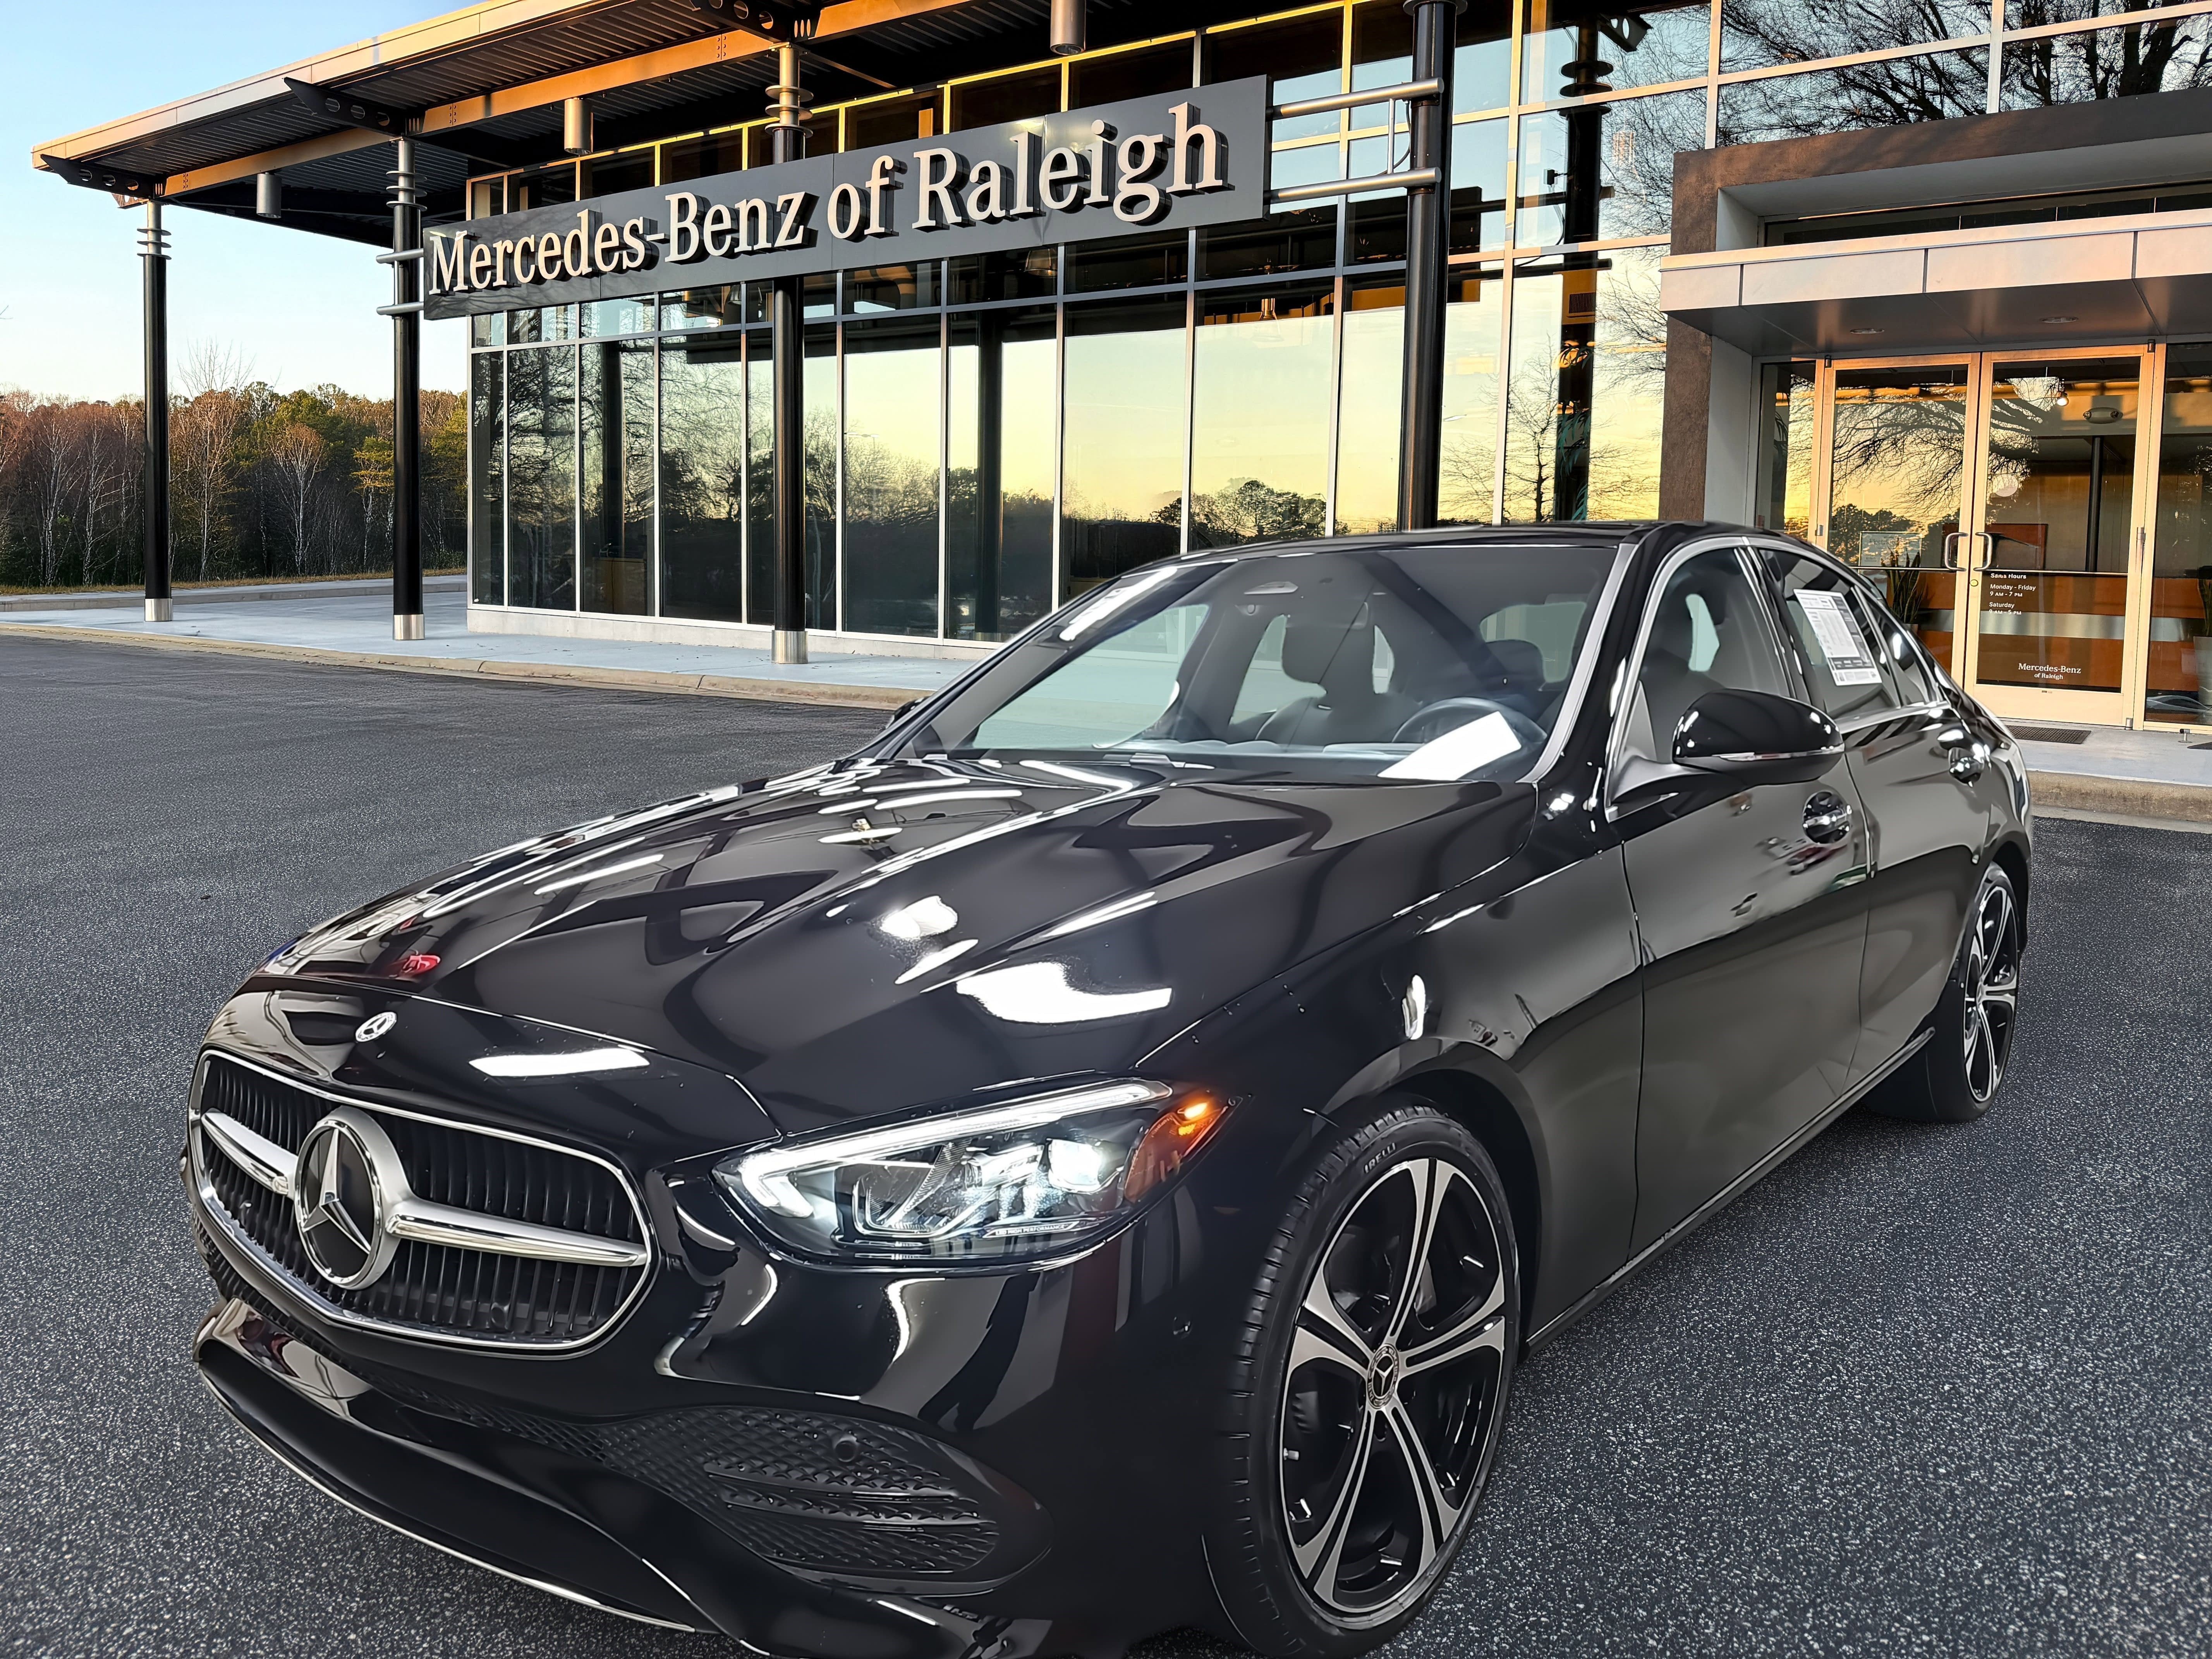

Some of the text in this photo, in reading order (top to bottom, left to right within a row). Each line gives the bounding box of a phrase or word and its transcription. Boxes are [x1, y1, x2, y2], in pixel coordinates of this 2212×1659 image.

[429, 102, 1223, 295] Mercedes-Benz of Raleigh
[2018, 663, 2081, 673] Mercedes-Benz
[1023, 1224, 1066, 1233] PERFORMANCE
